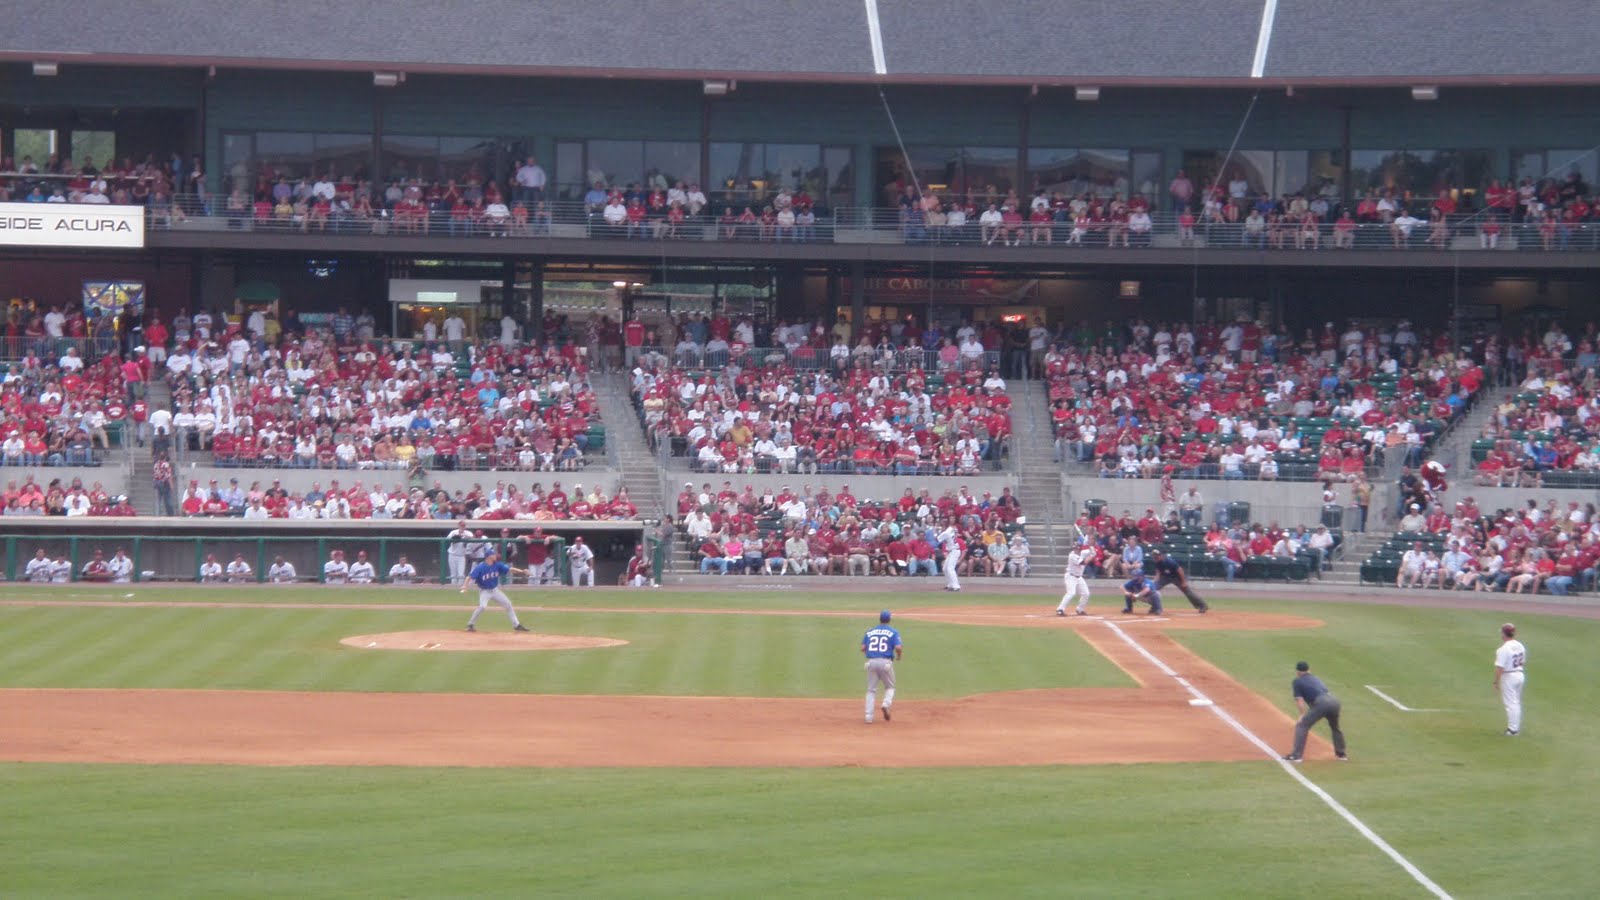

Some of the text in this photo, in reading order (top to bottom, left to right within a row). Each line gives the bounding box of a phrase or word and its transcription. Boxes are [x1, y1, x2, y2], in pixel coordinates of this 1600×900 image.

[0, 217, 132, 232] SIDE ACURA
[888, 278, 969, 290] CABOOSE
[868, 636, 888, 651] 26
